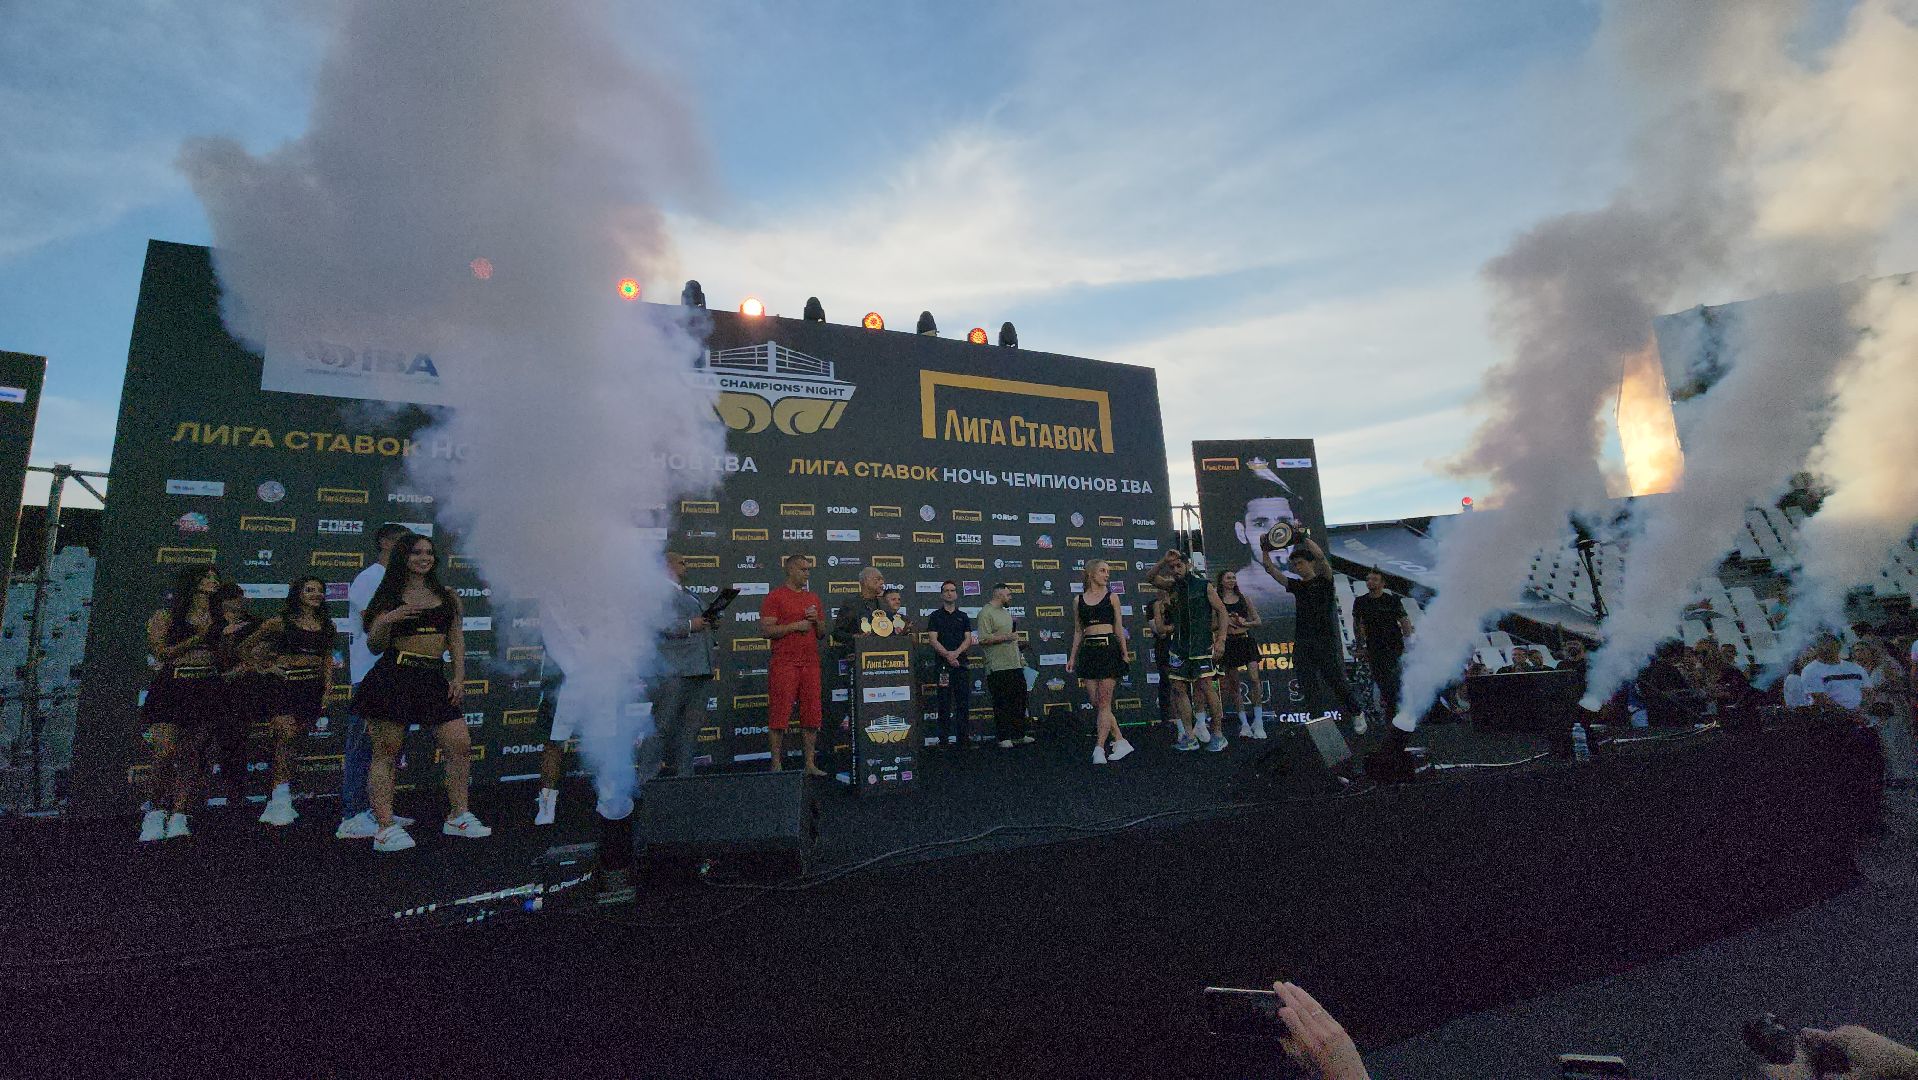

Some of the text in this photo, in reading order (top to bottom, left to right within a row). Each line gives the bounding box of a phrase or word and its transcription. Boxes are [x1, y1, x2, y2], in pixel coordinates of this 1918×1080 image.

[806, 384, 845, 397] NIGHT
[171, 421, 275, 448] ЛИГА
[283, 430, 420, 457] СТАВОК
[788, 457, 849, 476] ЛИГА
[854, 460, 938, 483] СТАВОК
[943, 467, 997, 486] НОЧЬ
[1001, 470, 1118, 493] ЧЕМПИОНОВ
[388, 493, 434, 504] РОЛЬФ
[827, 506, 858, 514] РОЛЬФ
[992, 513, 1019, 521] РОЛЬФ
[1132, 518, 1156, 526] РОЛЬФ
[782, 529, 814, 540] СОЮЗ
[456, 587, 492, 597] ОЛЬФ
